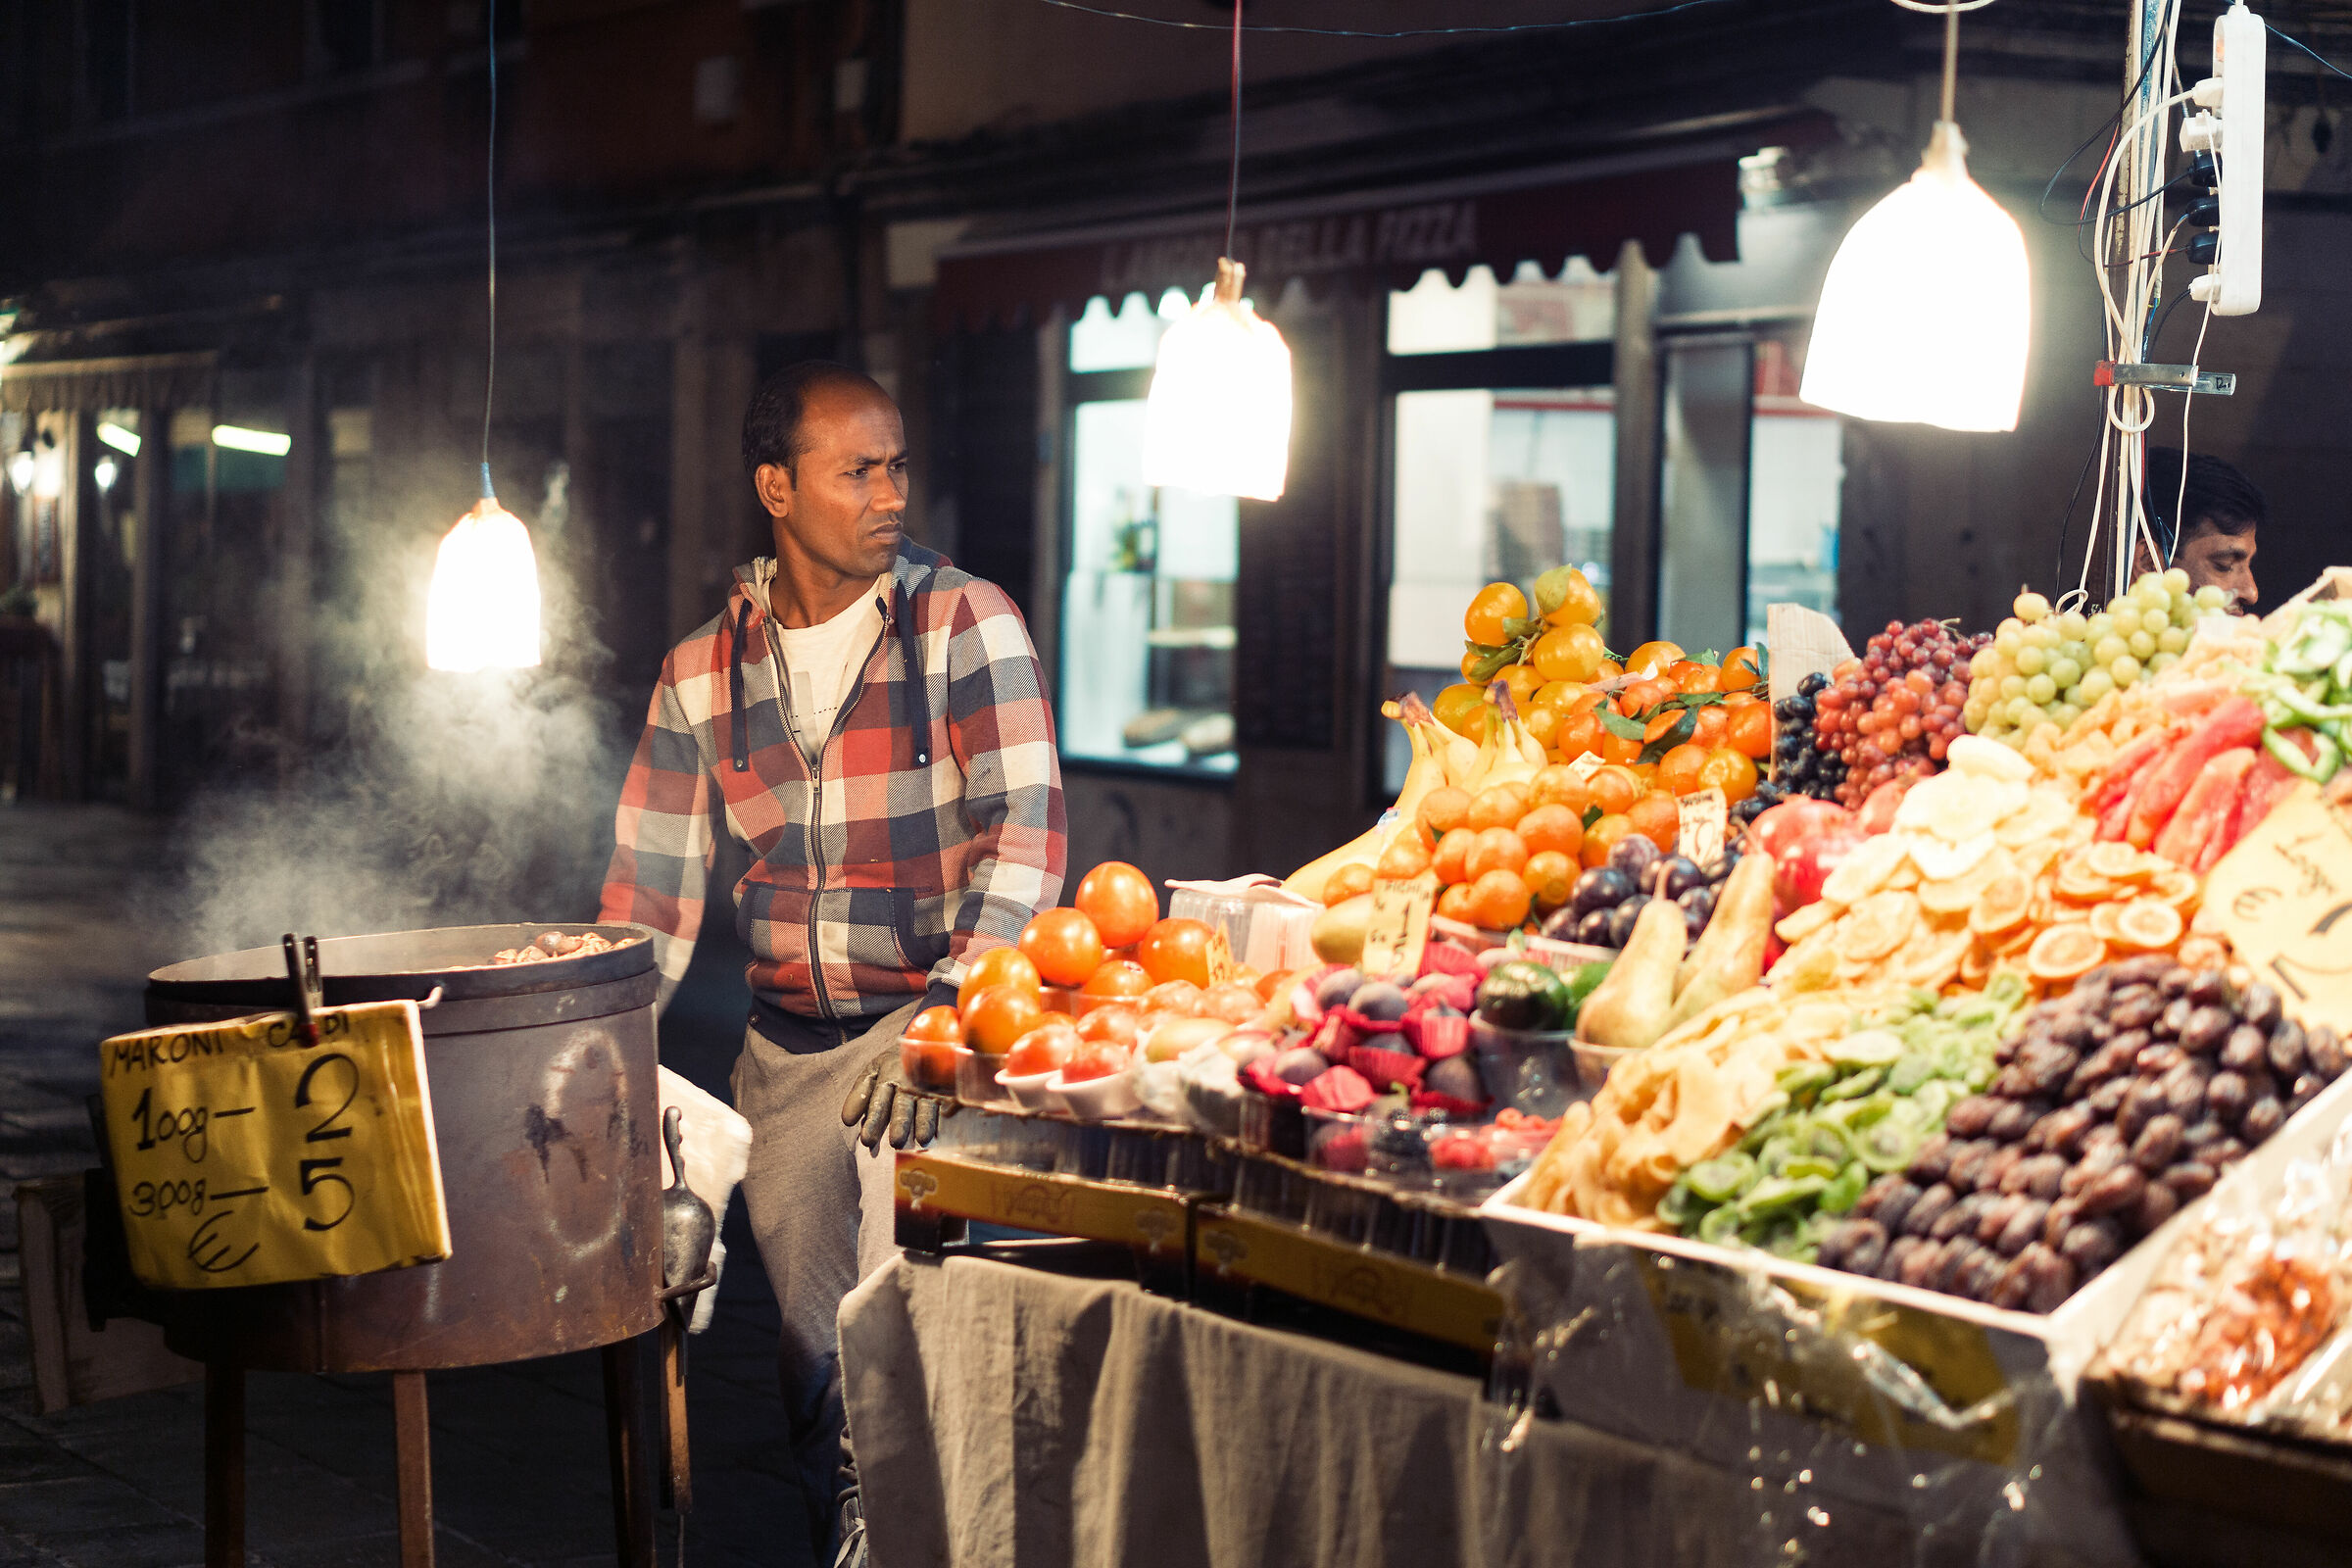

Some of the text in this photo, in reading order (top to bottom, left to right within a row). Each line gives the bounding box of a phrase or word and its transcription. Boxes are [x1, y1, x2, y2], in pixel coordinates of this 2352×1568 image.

[1375, 204, 1476, 265] PIZZA
[111, 1012, 351, 1077] MARONI CDI
[296, 1054, 360, 1143] 2
[300, 1156, 355, 1232] 5
[188, 1210, 260, 1272] €
